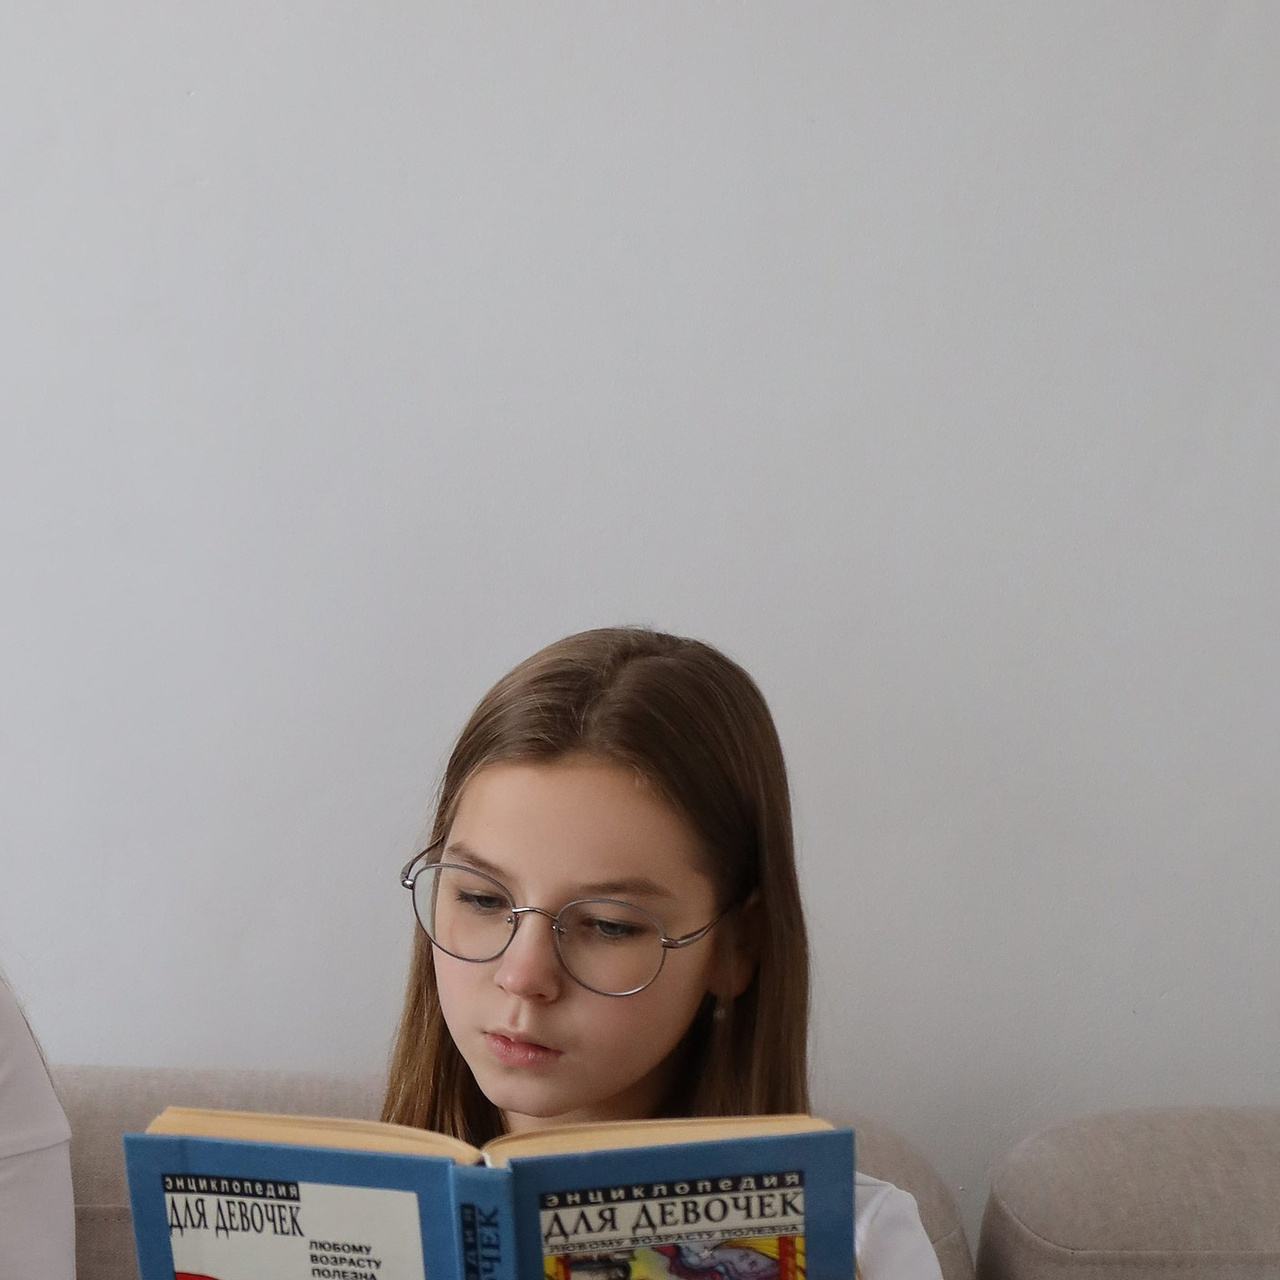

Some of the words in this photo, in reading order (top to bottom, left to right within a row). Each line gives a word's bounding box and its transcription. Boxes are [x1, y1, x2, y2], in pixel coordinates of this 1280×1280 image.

[170, 1197, 209, 1238] ДЛЯ
[215, 1198, 305, 1239] ДЕВОЧЕК
[543, 1207, 620, 1246] ДЛЯ
[631, 1191, 804, 1235] ДЕВОЧЕК
[309, 1240, 372, 1256] ЛЮБОМУ
[548, 1239, 624, 1254] ЛЮБОМУ
[631, 1230, 718, 1245] ВОЗРАСТУ
[720, 1223, 800, 1237] ПОЛЕЗНА
[310, 1254, 382, 1270] ВОЗРАСТУ
